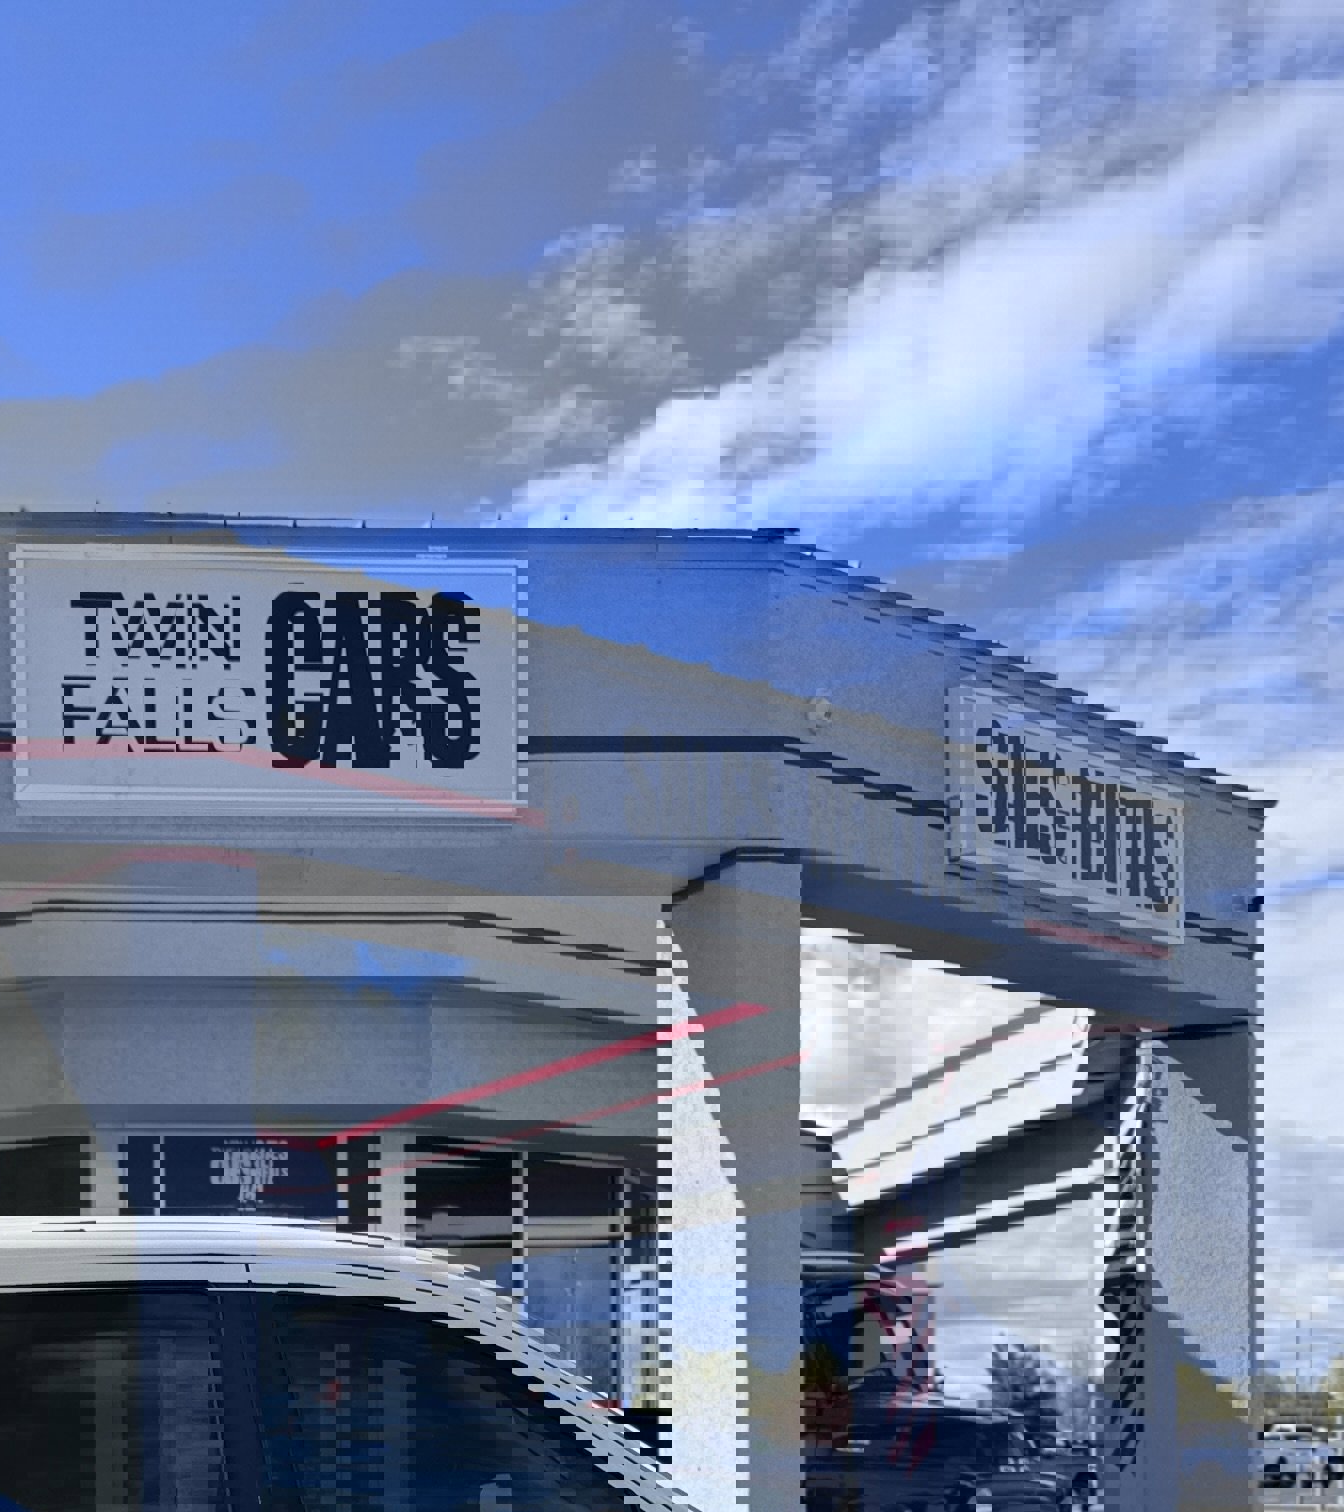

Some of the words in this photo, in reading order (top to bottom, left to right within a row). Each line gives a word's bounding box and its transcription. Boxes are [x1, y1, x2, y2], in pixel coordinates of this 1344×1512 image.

[71, 592, 241, 670] TWIN
[62, 676, 256, 752] FALLS
[265, 583, 480, 768] CARS
